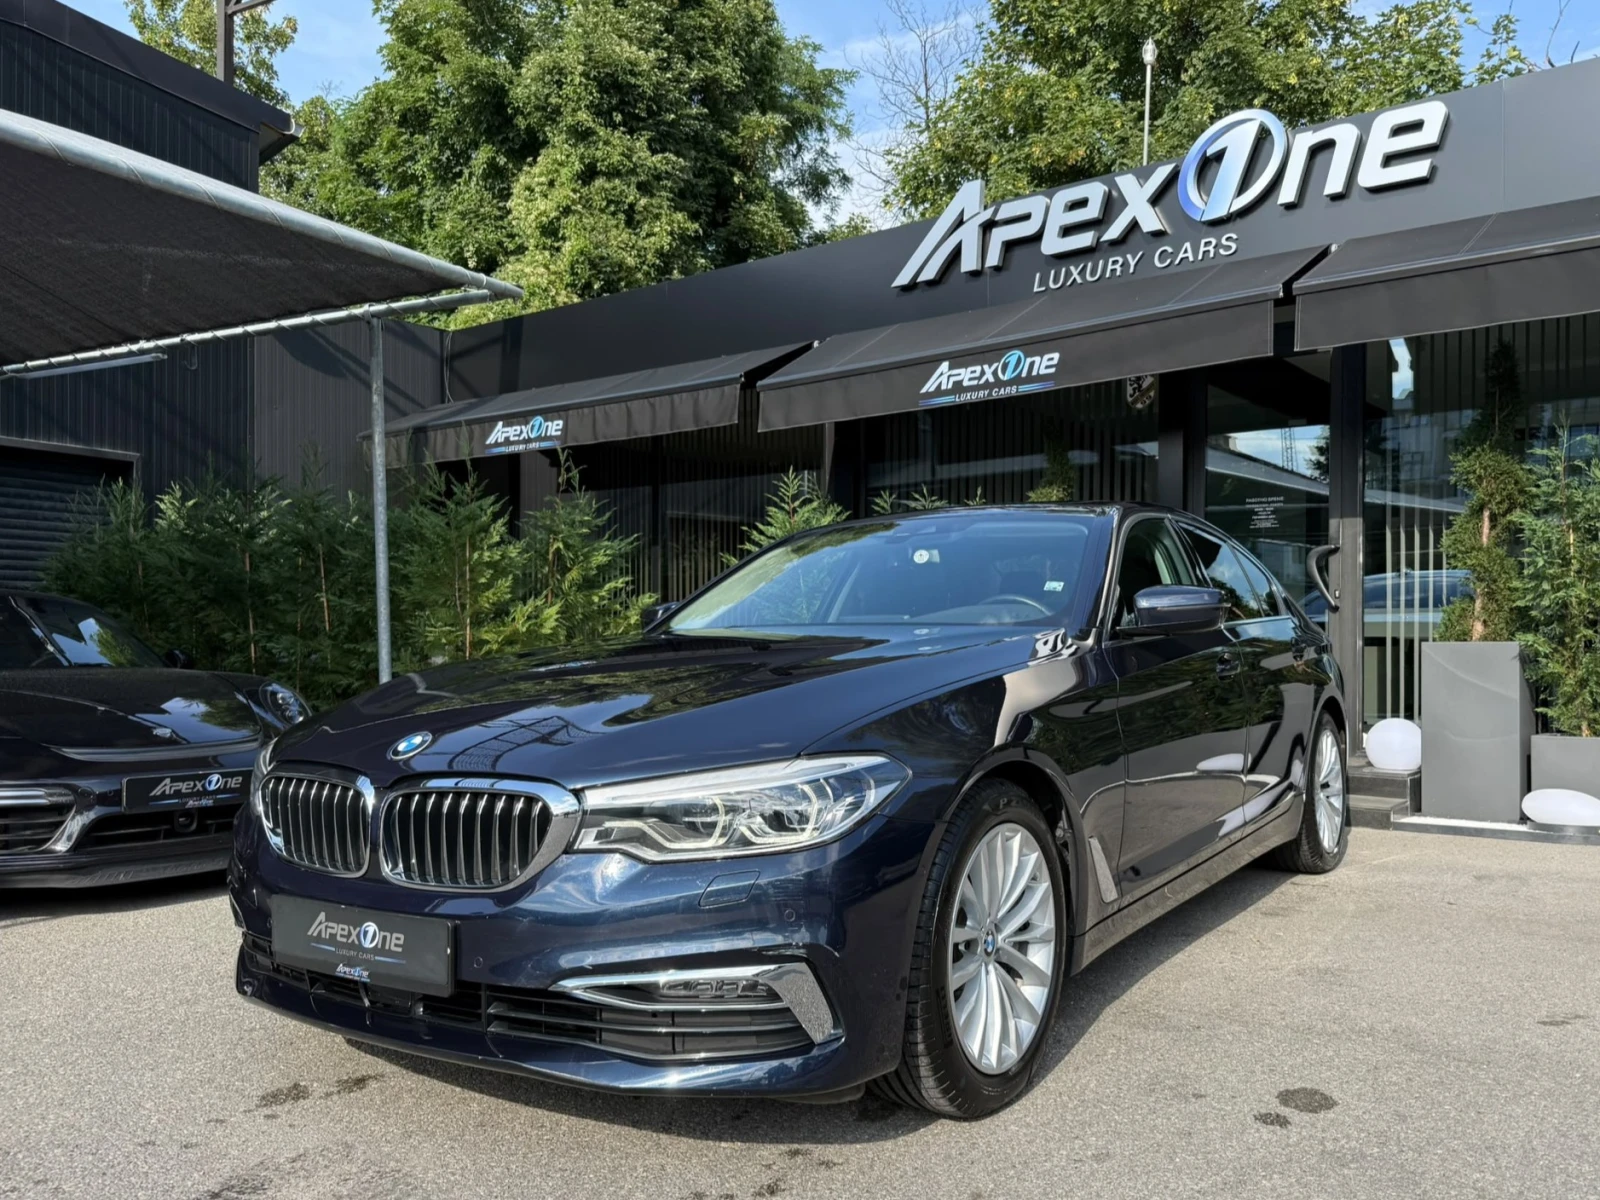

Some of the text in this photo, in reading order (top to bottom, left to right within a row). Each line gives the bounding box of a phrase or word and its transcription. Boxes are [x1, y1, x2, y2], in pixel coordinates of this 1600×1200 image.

[1033, 233, 1238, 293] LUXURY CARS
[955, 385, 1017, 402] LUXURY CARS
[335, 947, 375, 961] LUXURY CARS
